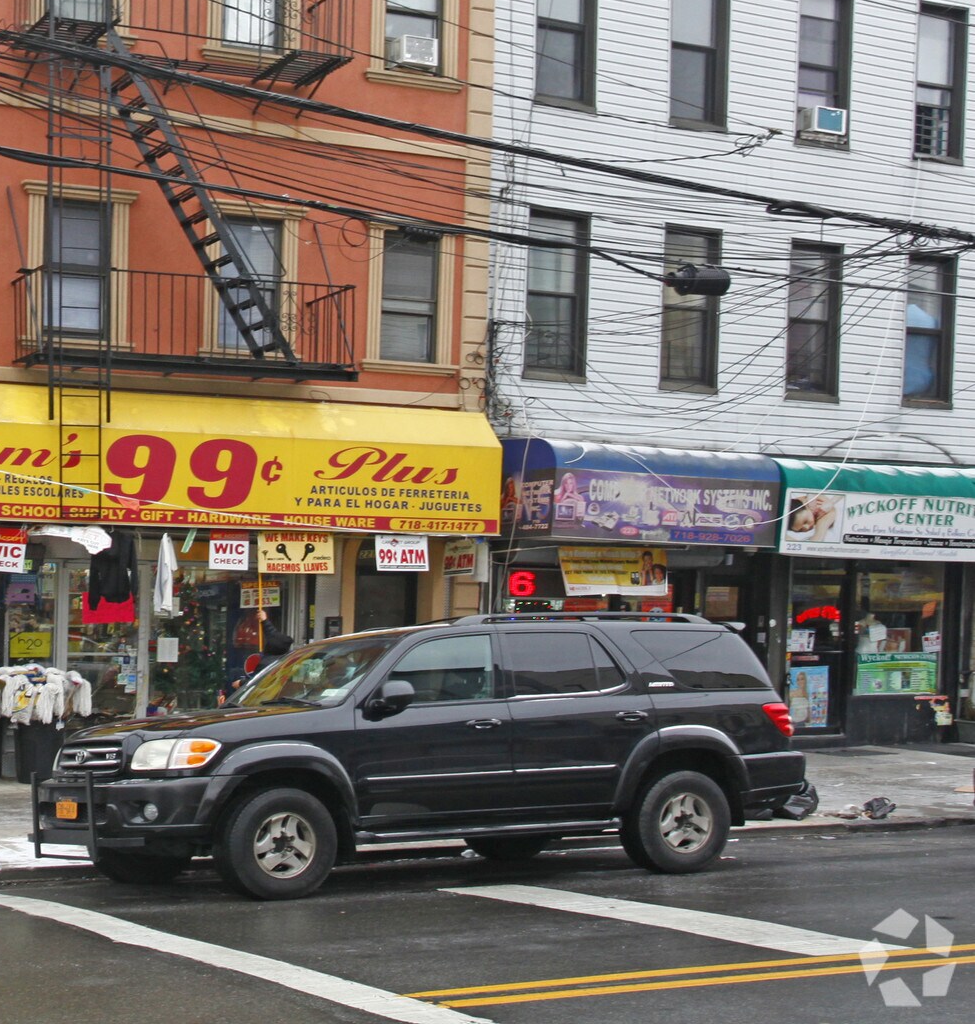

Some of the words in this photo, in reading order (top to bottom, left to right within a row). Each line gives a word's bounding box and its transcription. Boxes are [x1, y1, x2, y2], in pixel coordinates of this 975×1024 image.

[314, 446, 459, 485] Plus
[4, 473, 54, 485] REGALOS
[24, 486, 84, 499] ESCOLARES
[310, 485, 377, 497] ARTICULOS
[381, 487, 395, 497] DE
[399, 489, 470, 500] FERRETERIA
[295, 497, 302, 506] Y
[307, 497, 341, 508] PARA
[346, 499, 360, 509] EL
[365, 500, 409, 510] HOGAR
[419, 501, 482, 513] JUGUETES
[847, 498, 917, 519] WYCKOFF
[1, 505, 63, 517] SCHOOL
[69, 507, 126, 520] SUPPLY
[140, 510, 174, 522] GIFT
[187, 512, 271, 525] HARDWARE
[283, 515, 331, 527] HOUSE
[335, 517, 376, 528] WARE
[399, 520, 479, 532] 718-417-1477
[894, 513, 955, 526] CENTER
[265, 533, 279, 543] WE
[281, 533, 305, 542] MAKE
[307, 533, 329, 543] KEYS
[214, 542, 245, 555] WIC
[786, 543, 802, 551] 223
[400, 548, 426, 564] ATM
[456, 553, 474, 568] ATM
[266, 562, 301, 572] HACEMOS
[304, 562, 328, 571] LLAVES
[509, 571, 536, 596] 6
